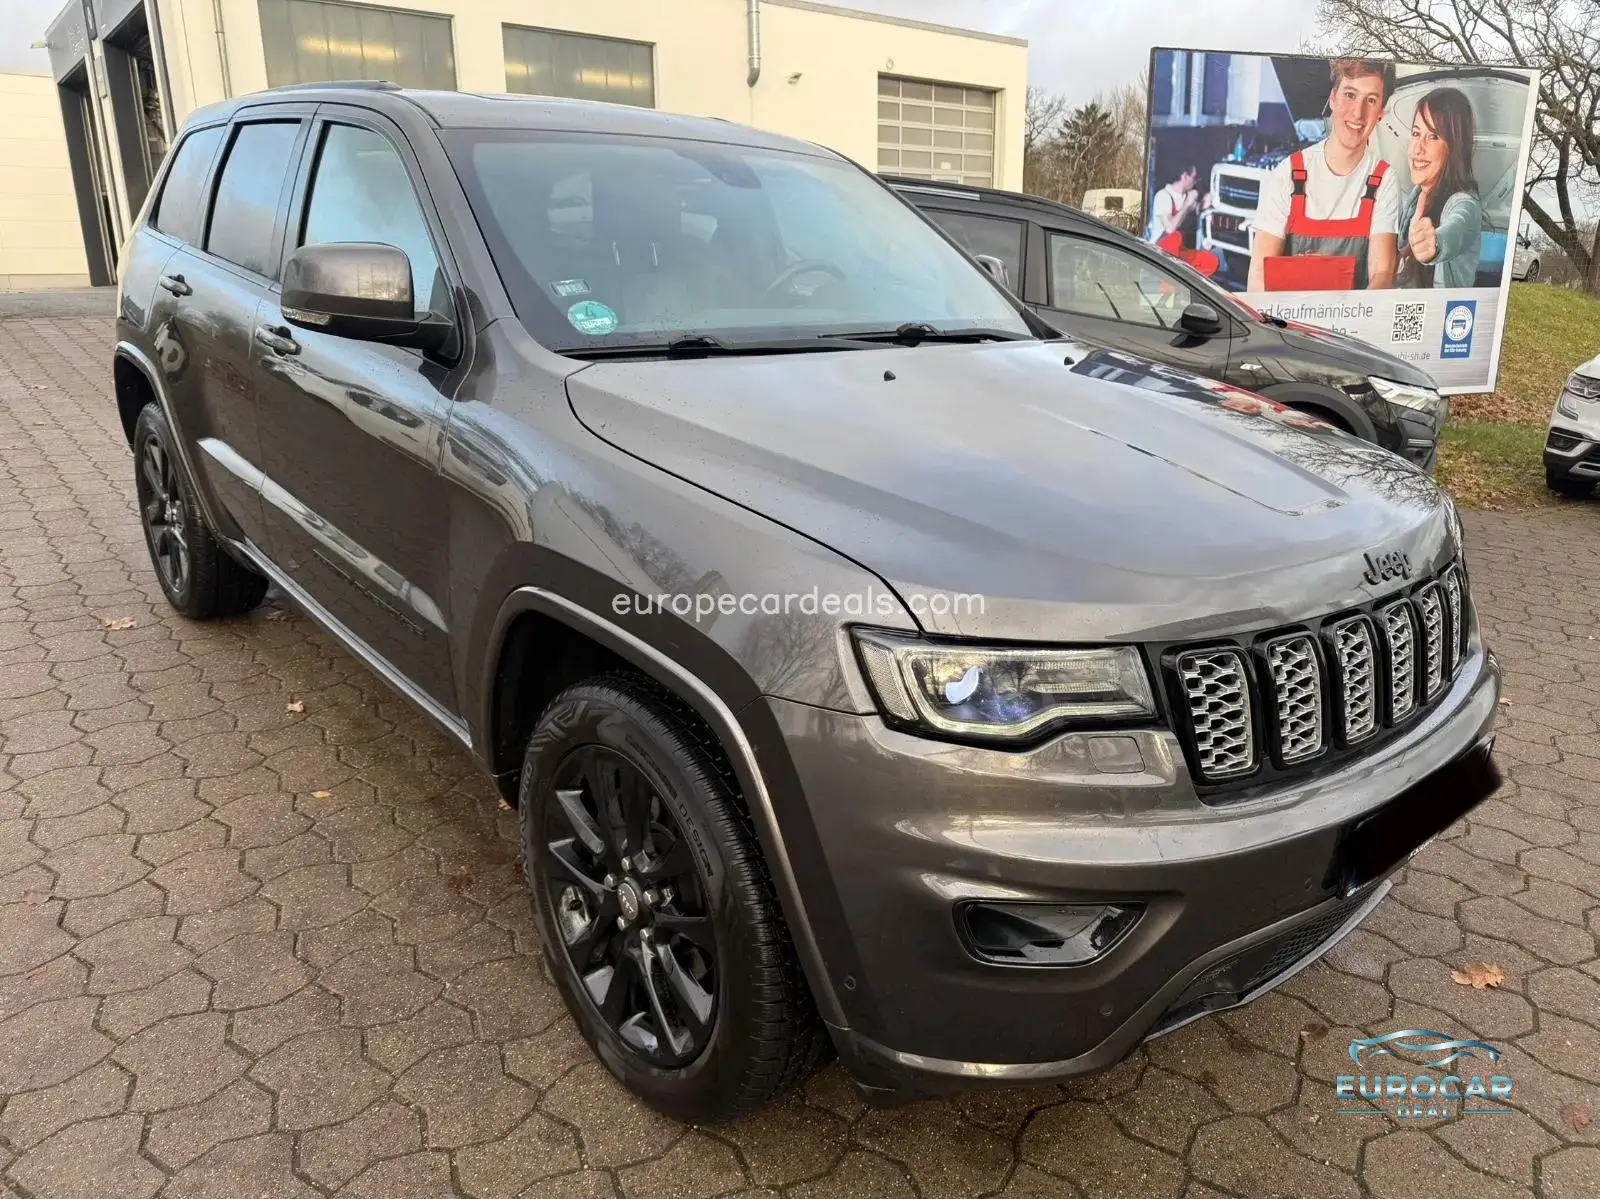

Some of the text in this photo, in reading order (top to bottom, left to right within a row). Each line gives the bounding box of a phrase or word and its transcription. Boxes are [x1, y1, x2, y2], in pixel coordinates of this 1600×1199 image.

[1277, 303, 1374, 320] kaufmännische
[1362, 549, 1412, 586] Jeep
[678, 803, 715, 878] DESIGN
